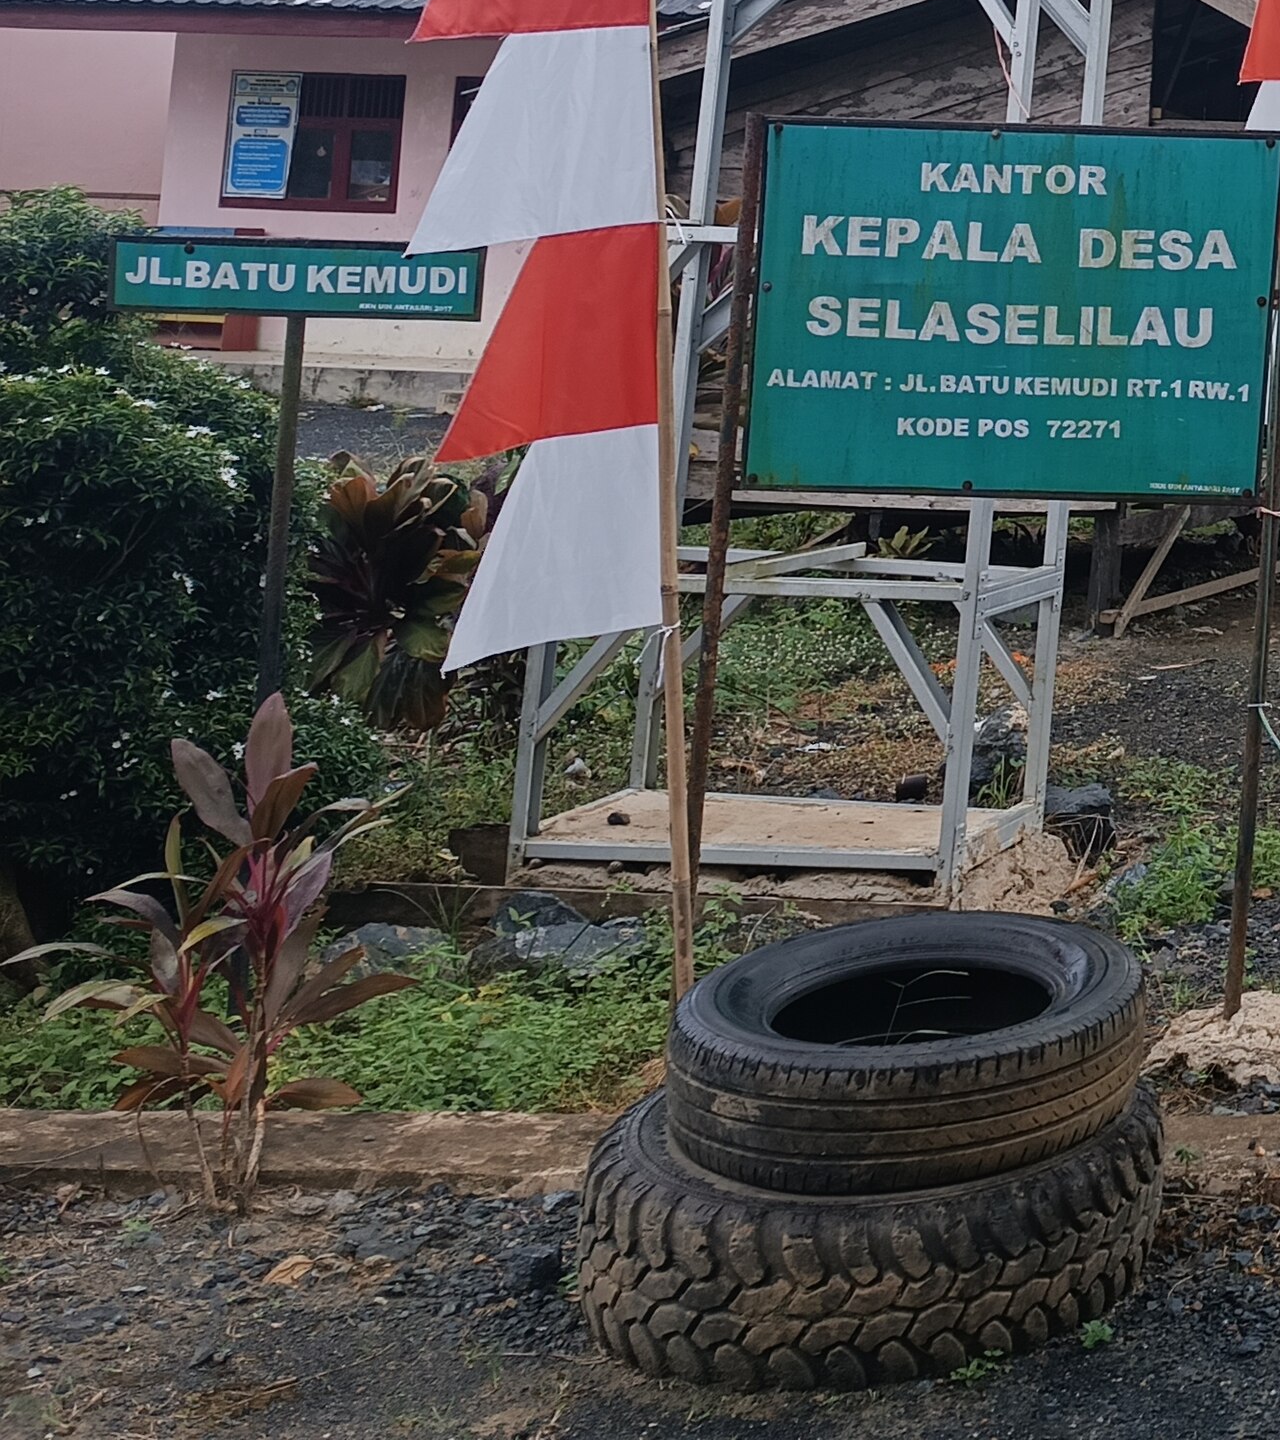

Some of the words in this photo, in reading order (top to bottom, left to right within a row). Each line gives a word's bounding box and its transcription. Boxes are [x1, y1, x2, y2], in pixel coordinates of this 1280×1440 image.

[920, 162, 1107, 195] KANTOR
[801, 215, 1041, 264] KEPALA
[1078, 229, 1237, 270] DESA
[307, 266, 467, 294] KEMUDI
[805, 296, 1213, 348] SELASELILAU
[767, 368, 877, 390] ALAMAT
[1014, 376, 1117, 397] KEMUDI
[897, 417, 969, 437] KODE
[977, 419, 1029, 438] POS
[1047, 419, 1121, 438] 72271
